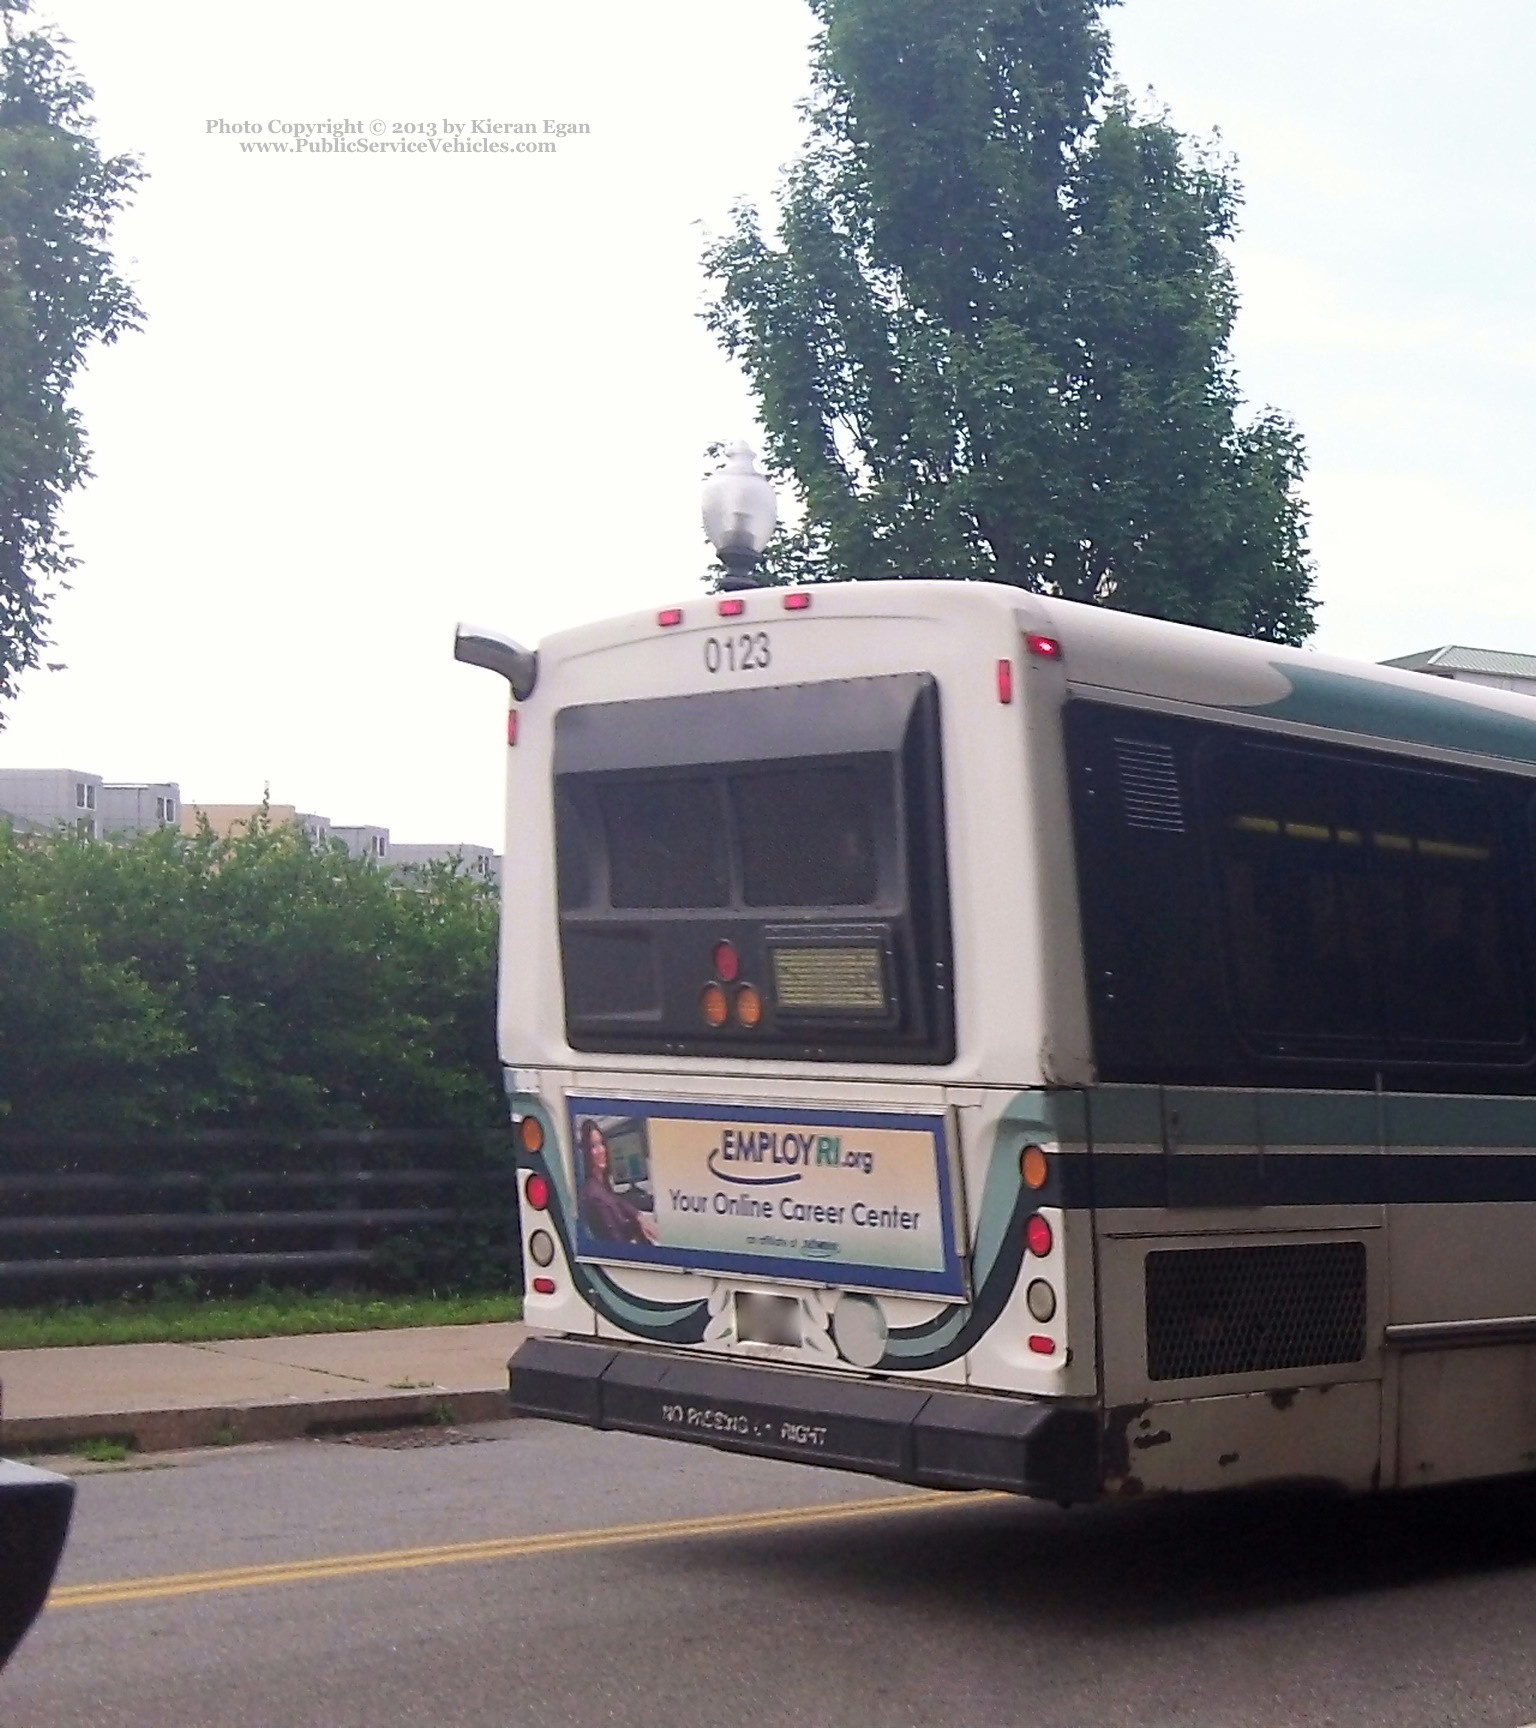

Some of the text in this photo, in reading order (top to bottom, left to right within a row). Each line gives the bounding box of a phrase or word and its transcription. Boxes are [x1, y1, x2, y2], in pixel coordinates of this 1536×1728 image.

[704, 631, 771, 673] 0123
[723, 1129, 873, 1174] EMPLOYRI.org
[669, 1188, 920, 1231] Your Online Career Center
[661, 1404, 684, 1422] NO
